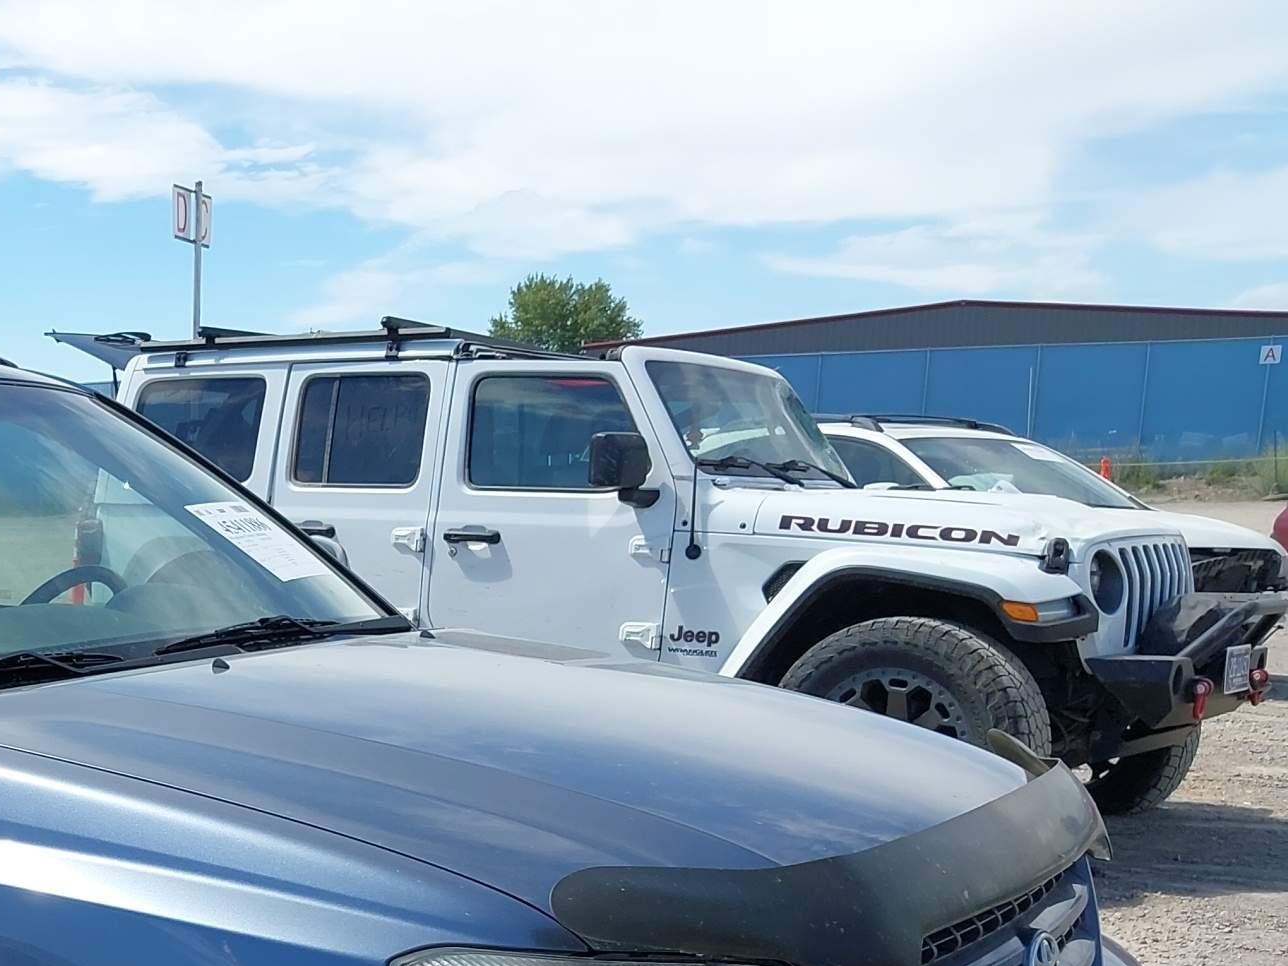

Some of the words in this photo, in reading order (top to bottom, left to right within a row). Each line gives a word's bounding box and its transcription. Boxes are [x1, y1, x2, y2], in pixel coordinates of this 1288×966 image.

[1263, 347, 1277, 361] A
[778, 514, 1021, 548] RUBICON
[669, 624, 720, 648] Jeep
